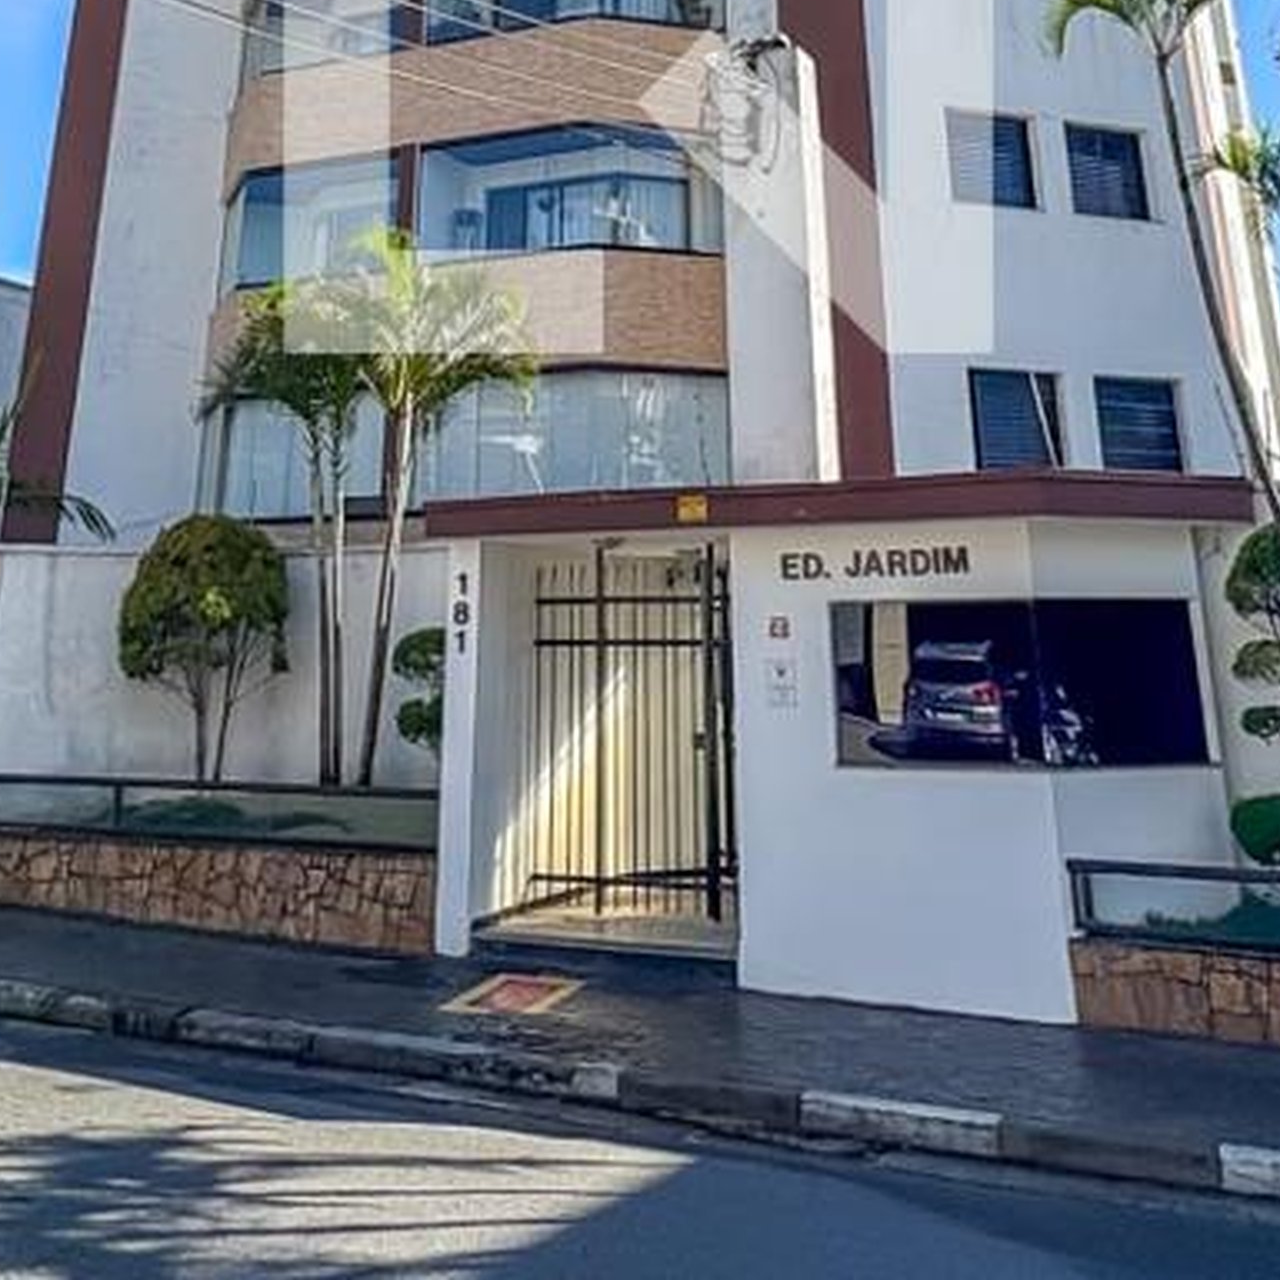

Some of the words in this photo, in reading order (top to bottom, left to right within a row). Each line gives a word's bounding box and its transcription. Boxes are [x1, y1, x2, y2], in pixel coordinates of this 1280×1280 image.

[780, 552, 832, 580] ED.
[845, 546, 970, 578] JARDIM
[453, 572, 469, 654] 181
